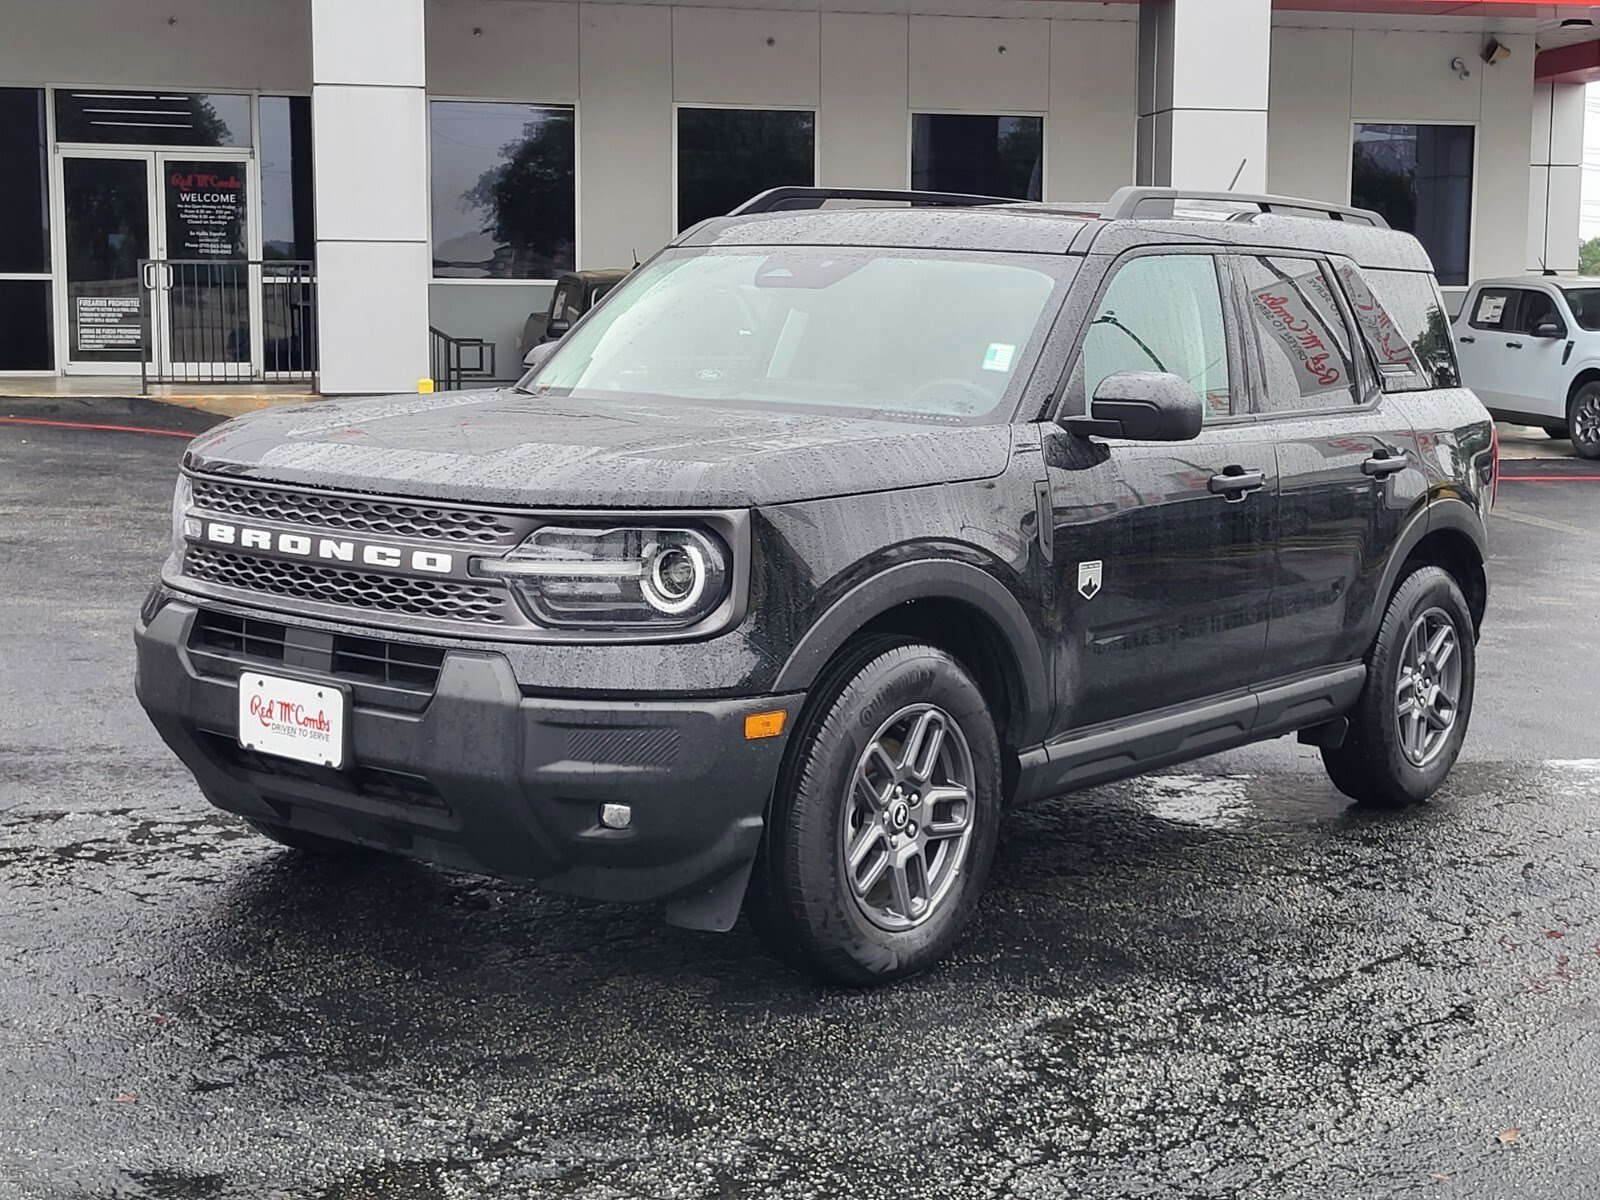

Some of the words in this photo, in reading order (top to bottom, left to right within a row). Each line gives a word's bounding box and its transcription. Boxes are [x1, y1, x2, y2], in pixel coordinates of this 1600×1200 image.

[179, 192, 237, 203] WELCOME
[208, 522, 452, 573] BRONCO
[250, 694, 274, 727] Red
[276, 700, 330, 732] McCombs
[271, 722, 297, 735] DRIVEN
[299, 727, 308, 738] TO
[309, 730, 330, 742] SERVE
